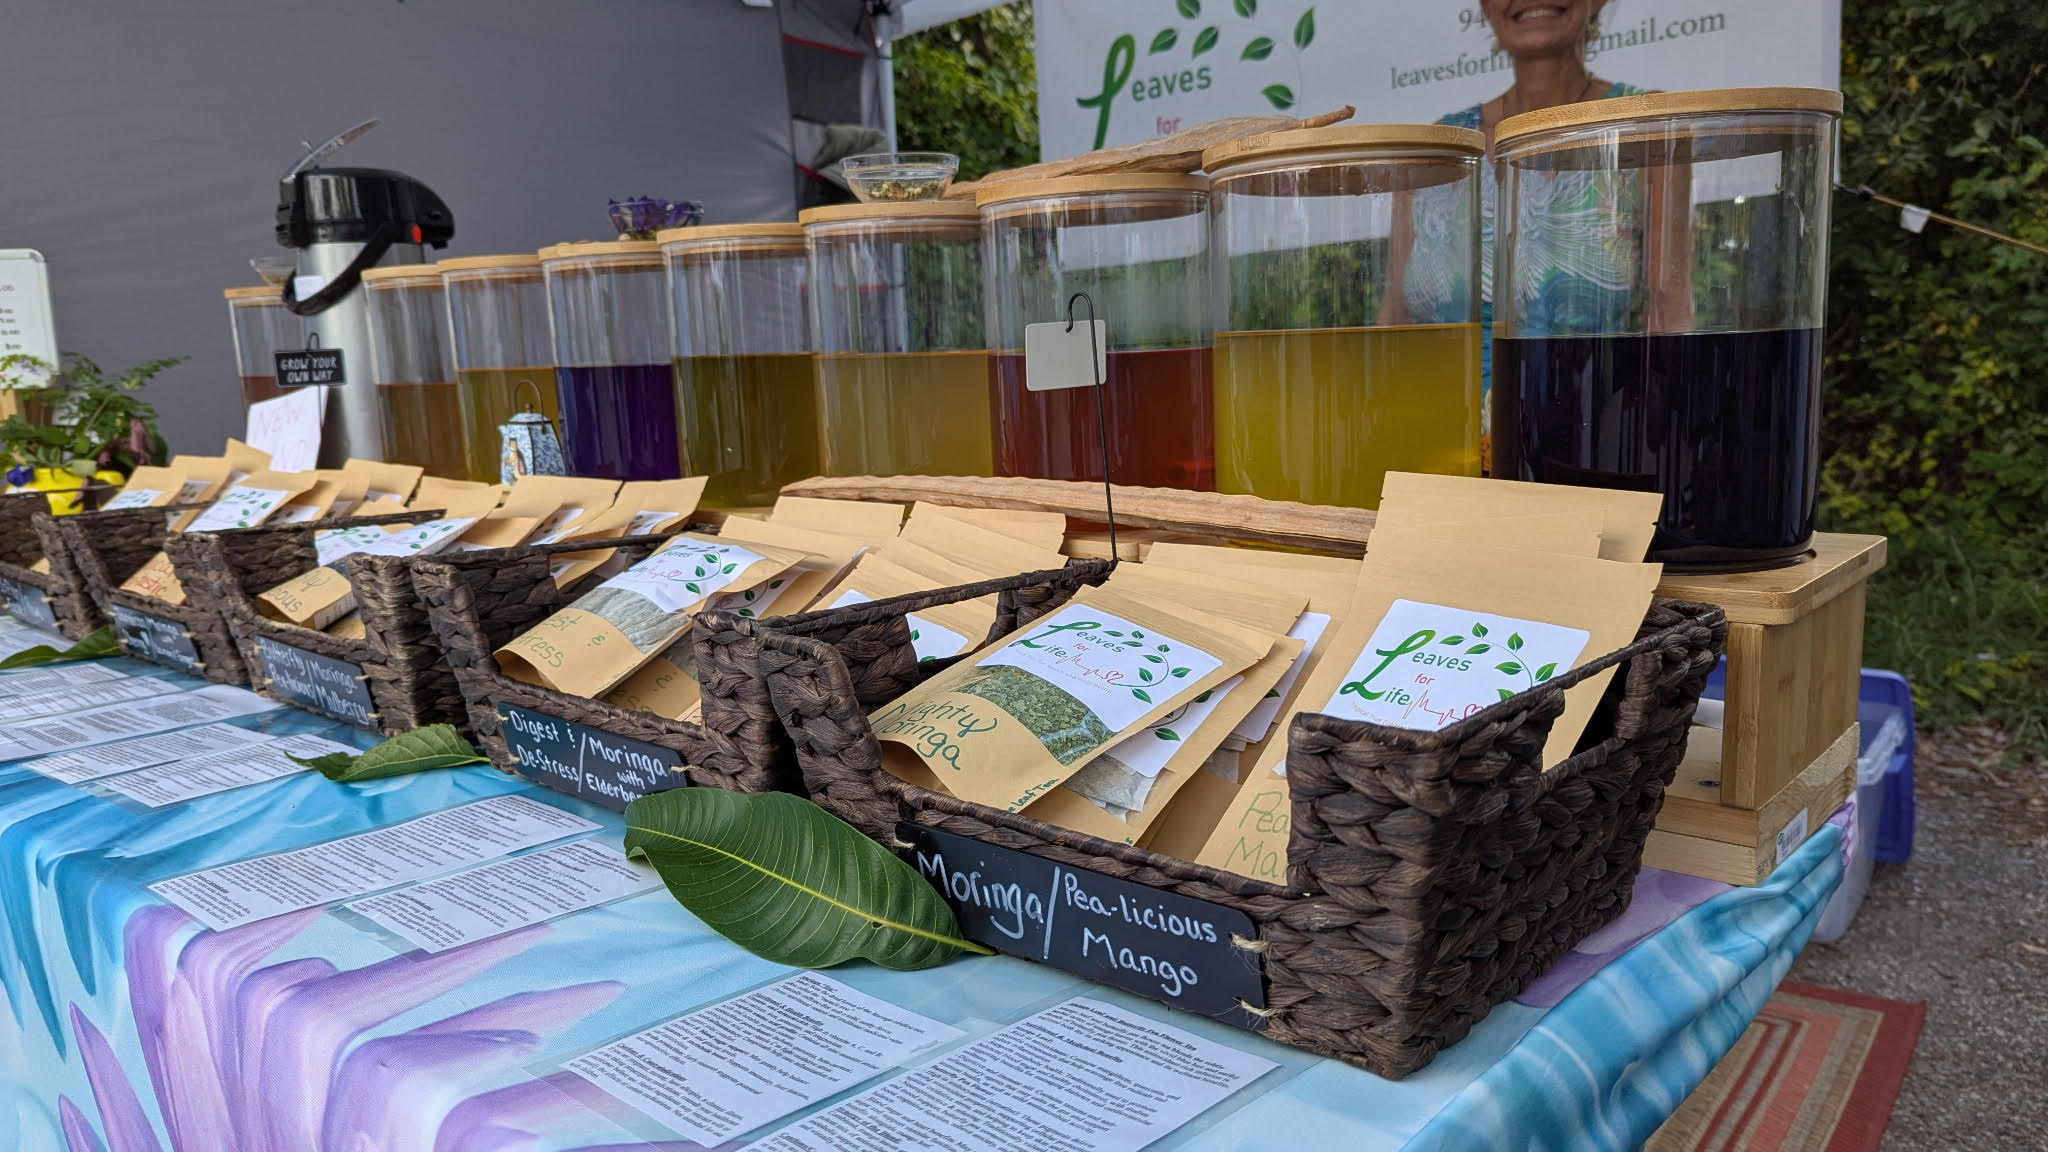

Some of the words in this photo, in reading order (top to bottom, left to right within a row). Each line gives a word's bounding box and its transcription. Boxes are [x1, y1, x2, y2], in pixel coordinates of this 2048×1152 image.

[1156, 116, 1182, 135] for
[280, 358, 308, 370] GROW
[312, 356, 337, 369] YOUR
[287, 371, 309, 383] OWN
[311, 370, 334, 381] WAY
[1073, 643, 1091, 652] for
[310, 660, 358, 694] Moringa
[1414, 673, 1436, 686] for
[315, 683, 369, 726] Mulberry
[509, 710, 559, 743] Digest
[516, 744, 579, 782] De-Stress
[589, 736, 668, 785] Moringa
[617, 768, 646, 790] with
[917, 851, 1045, 939] Moringa
[1064, 872, 1218, 944] Pea-licious
[1082, 926, 1198, 997] Mango
